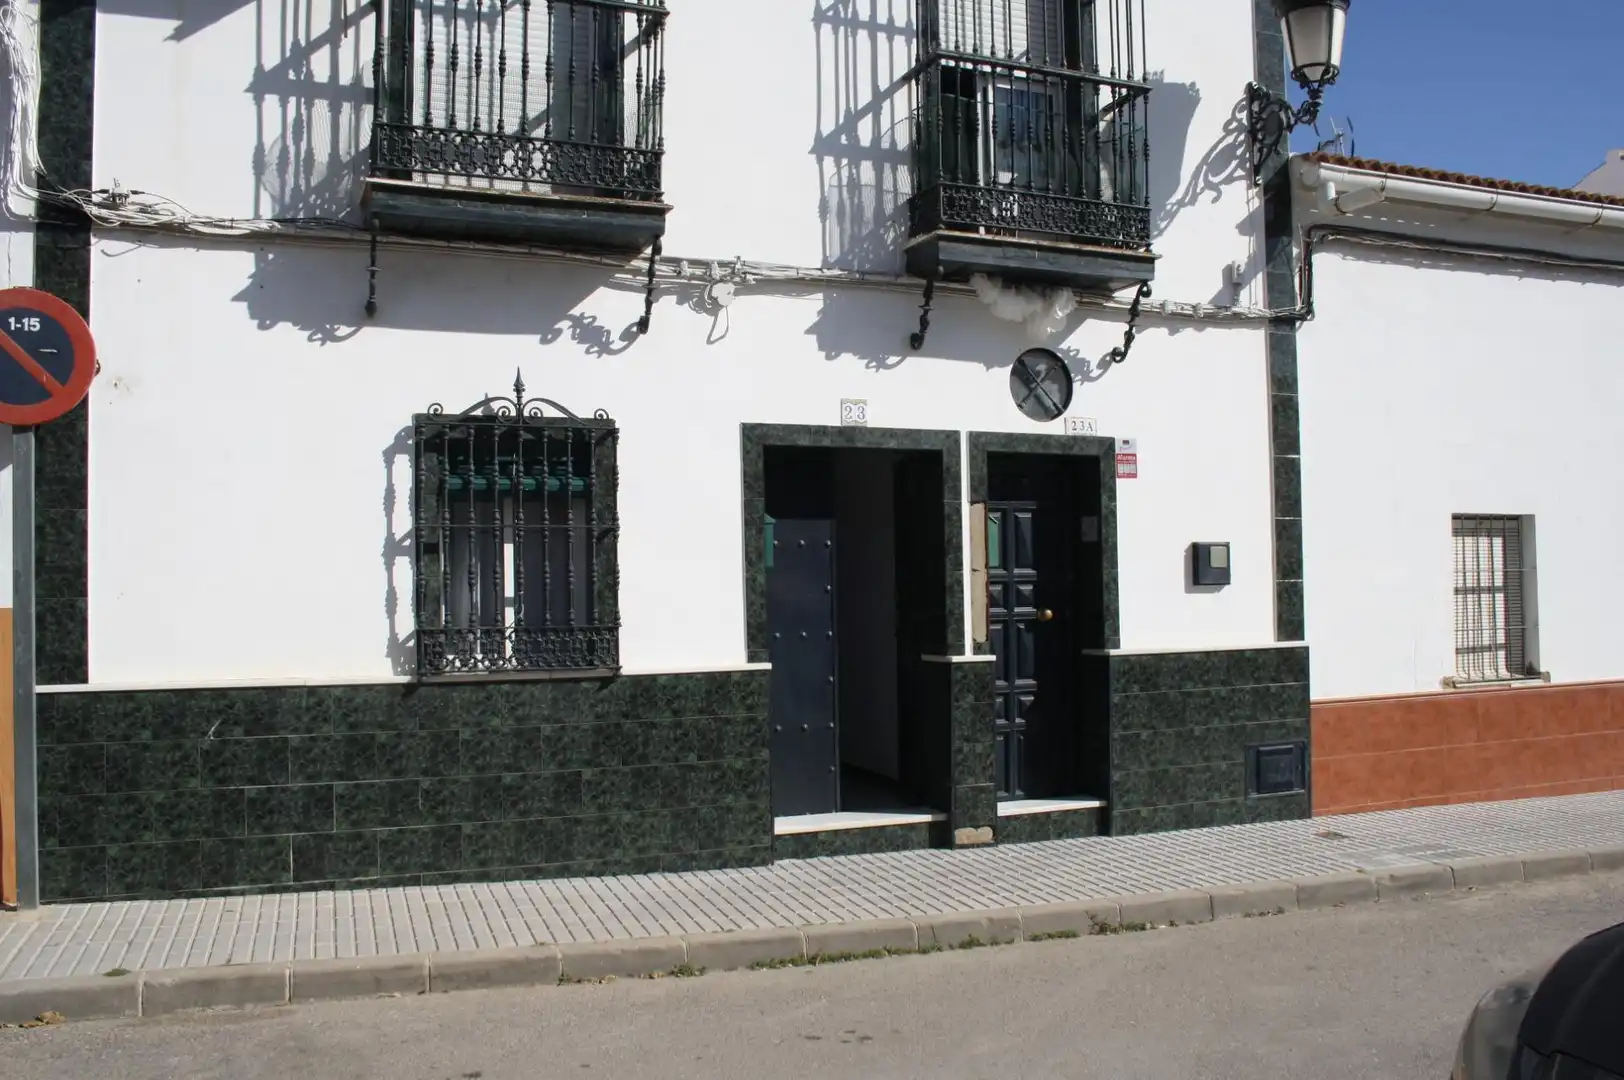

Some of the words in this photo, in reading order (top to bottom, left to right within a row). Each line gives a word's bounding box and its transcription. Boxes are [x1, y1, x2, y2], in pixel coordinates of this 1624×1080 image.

[8, 316, 41, 331] 1-15
[844, 405, 866, 420] 23
[1071, 420, 1093, 431] 23A
